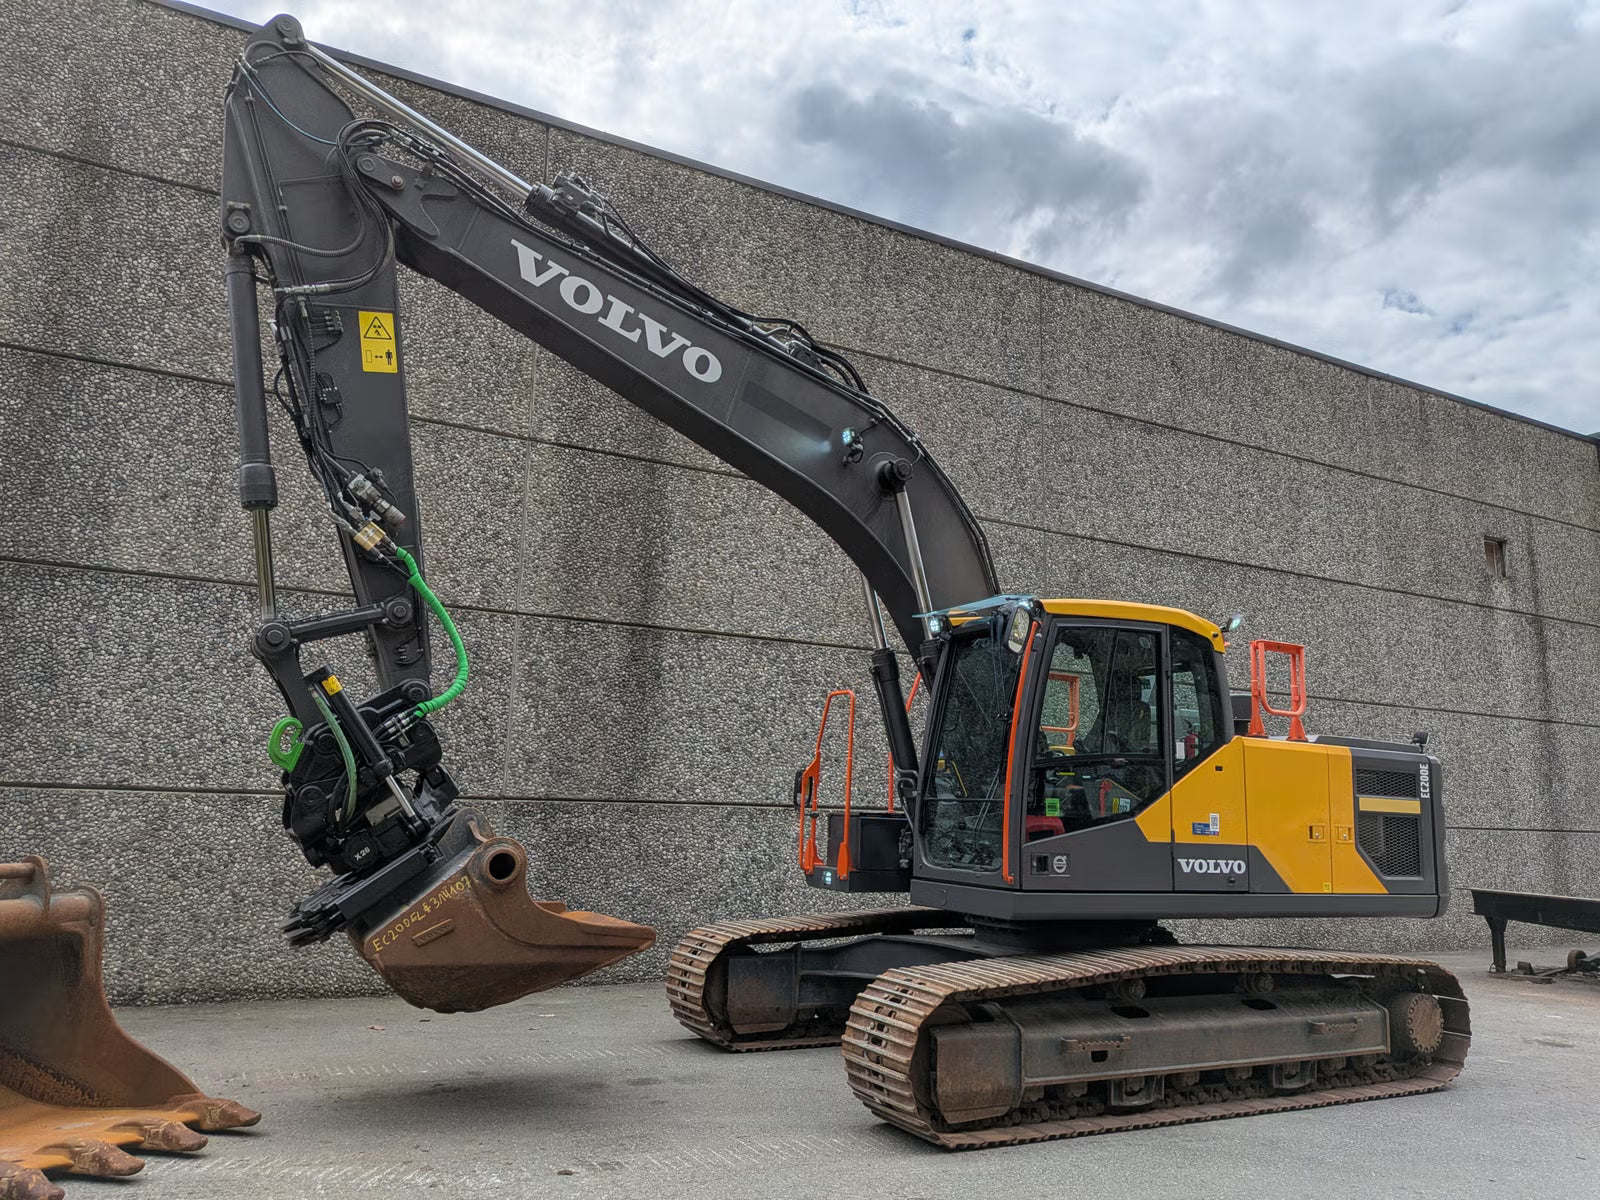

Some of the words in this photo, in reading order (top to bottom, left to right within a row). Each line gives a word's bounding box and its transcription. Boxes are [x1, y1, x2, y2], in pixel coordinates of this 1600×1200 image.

[511, 239, 722, 383] VOLVO
[1419, 763, 1430, 799] EC200E
[1177, 858, 1246, 875] VOLVO
